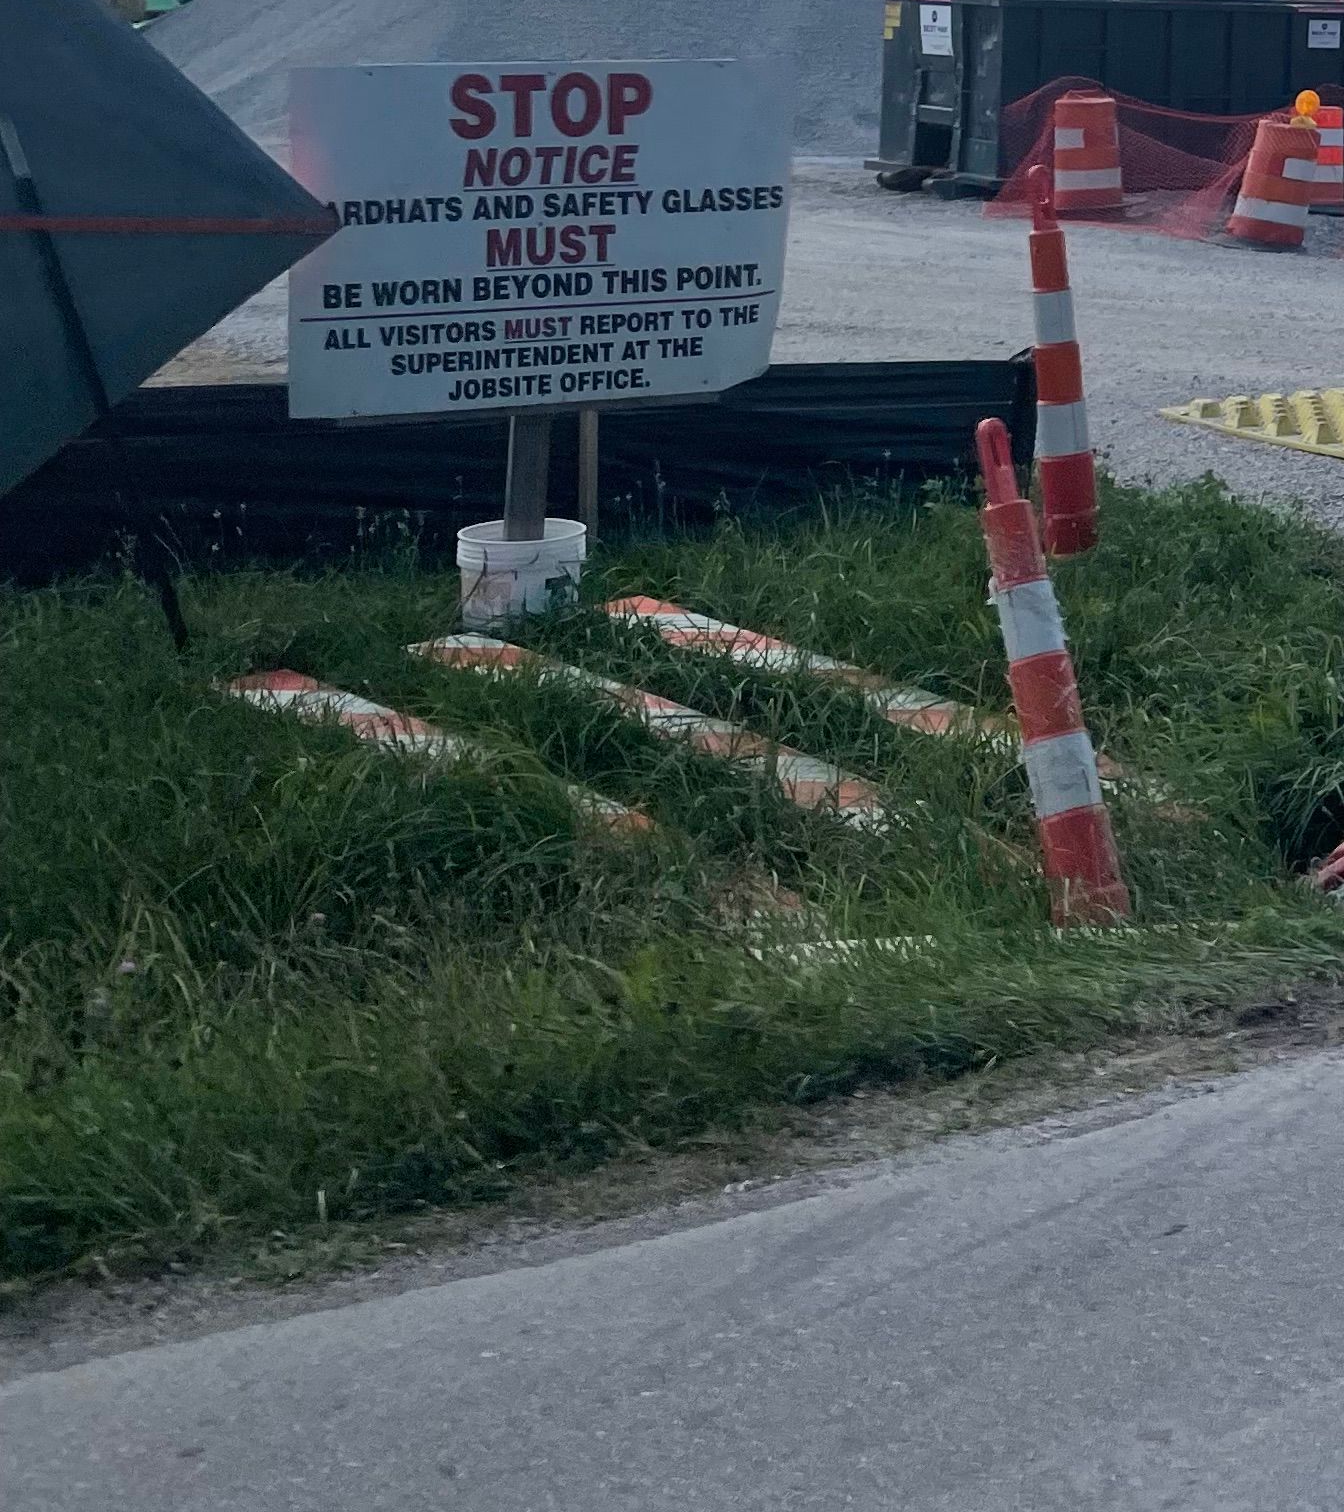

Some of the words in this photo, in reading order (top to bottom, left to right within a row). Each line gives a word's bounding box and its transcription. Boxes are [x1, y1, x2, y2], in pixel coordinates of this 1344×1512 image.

[448, 72, 653, 140] STOP
[463, 145, 639, 187] NOTICE
[472, 193, 534, 221] AND
[543, 190, 653, 218] SAFETY
[661, 186, 784, 214] GLASSES
[486, 224, 617, 268] MUST
[323, 283, 363, 309] BE
[372, 278, 463, 307] WORN
[473, 272, 593, 301] BEYOND
[602, 268, 668, 295] THIS
[677, 264, 762, 291] POINT.
[324, 327, 371, 350] ALL
[379, 320, 497, 347] VISITORS
[504, 316, 573, 340] MUST
[580, 311, 675, 336] REPORT
[681, 308, 712, 330] TO
[720, 304, 760, 327] THE
[391, 342, 615, 376] SUPERINTENDENT
[621, 340, 650, 361] AT
[657, 336, 704, 359] THE
[448, 374, 552, 402] JOBSITE
[560, 368, 651, 393] OFFICE.
